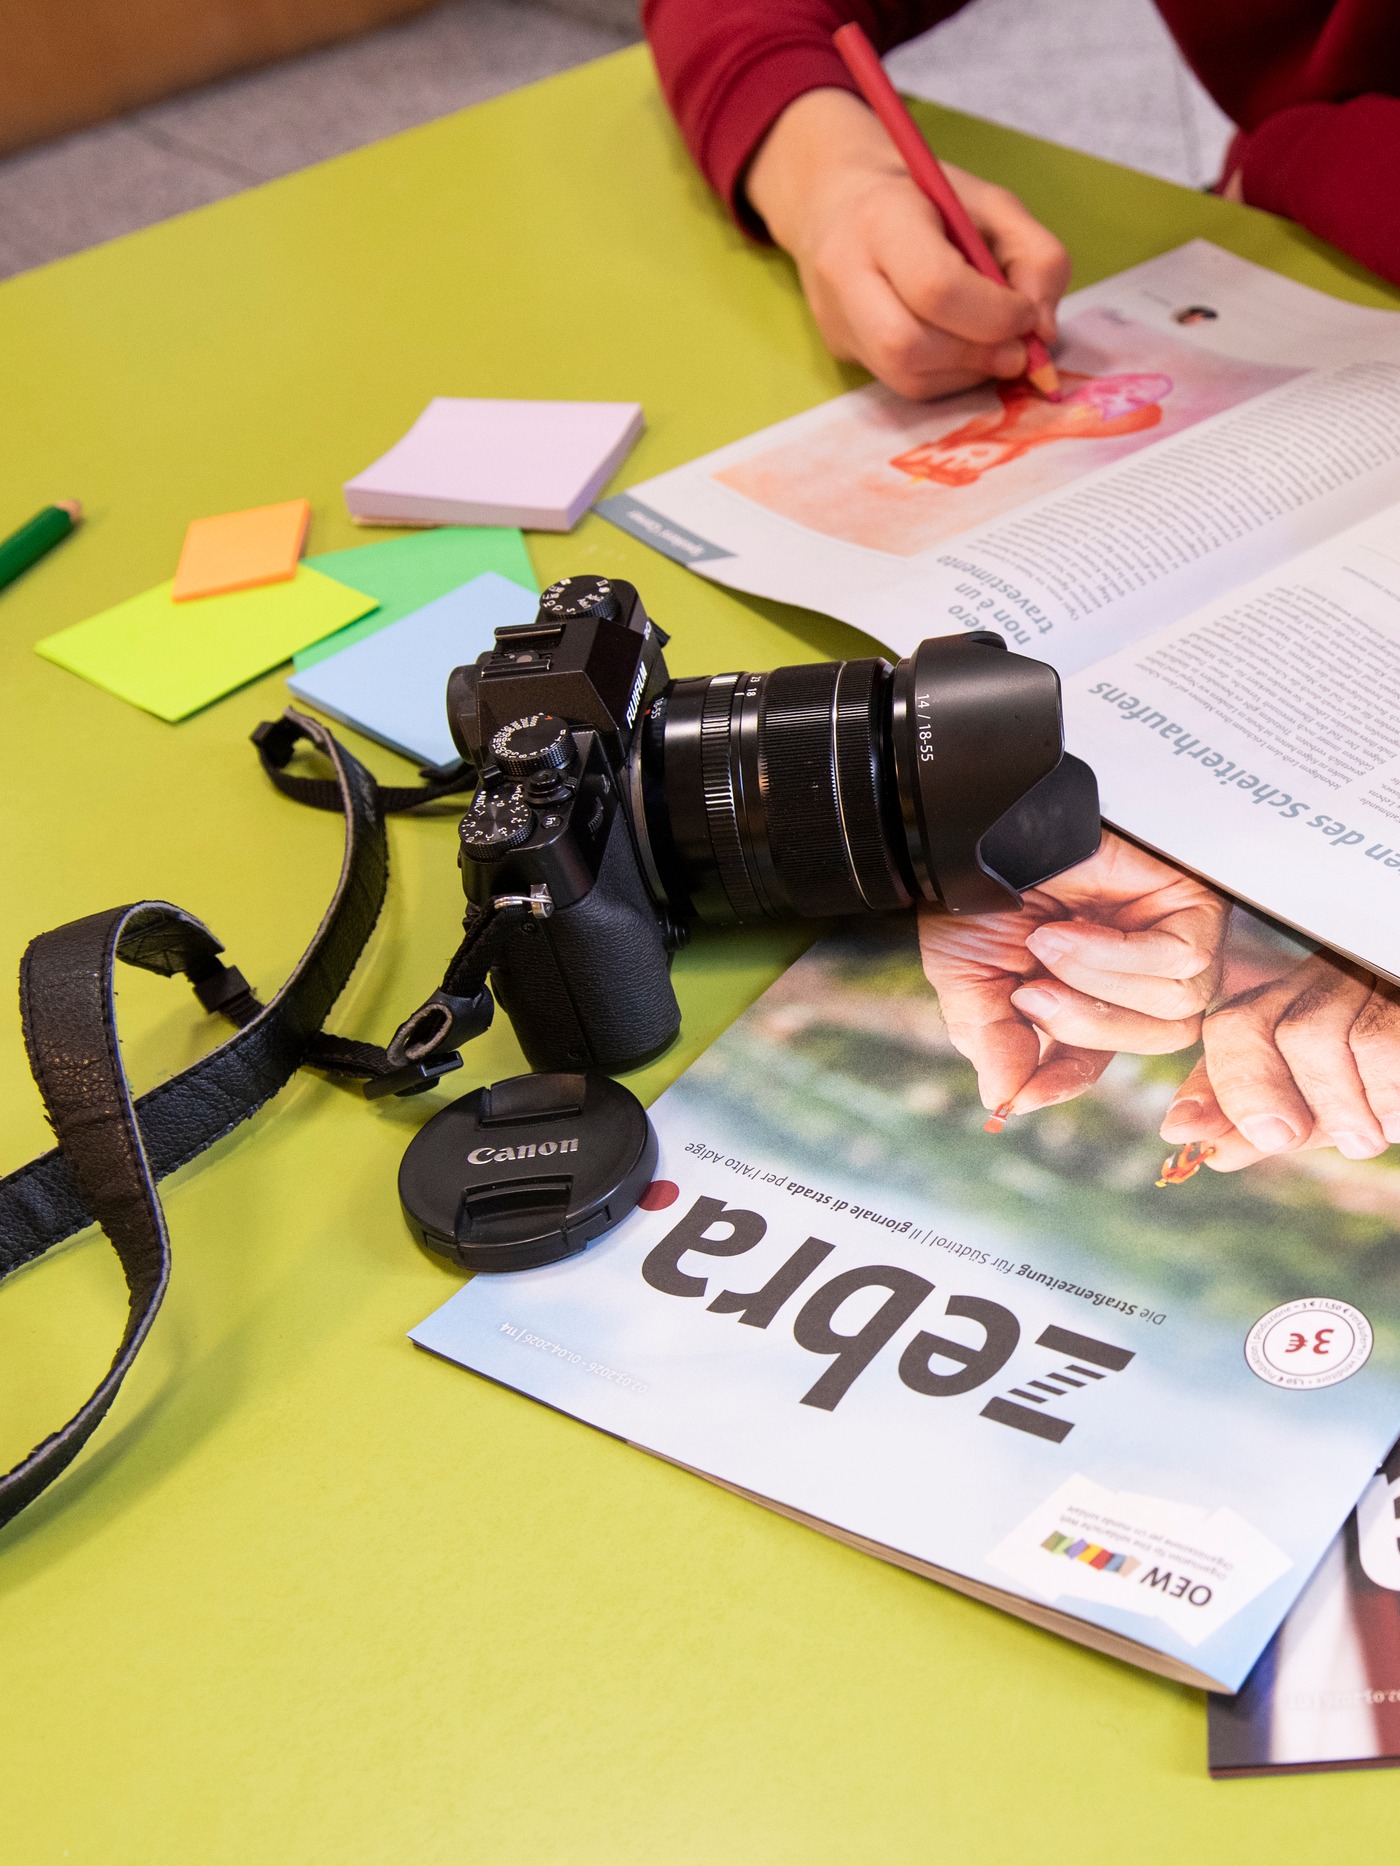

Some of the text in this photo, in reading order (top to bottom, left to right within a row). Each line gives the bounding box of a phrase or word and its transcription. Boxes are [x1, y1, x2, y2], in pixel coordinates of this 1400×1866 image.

[936, 555, 1053, 634] travestimento
[955, 583, 1031, 645] non è un
[917, 693, 934, 762] 14 18-55
[1088, 680, 1310, 820] Scheiterhaufens
[1365, 790, 1398, 807] Lebens
[1305, 813, 1364, 852] des
[467, 1137, 580, 1165] Canon
[684, 1139, 726, 1167] Adige
[761, 1168, 789, 1189] per
[785, 1181, 833, 1209] strada
[830, 1197, 850, 1215] di
[850, 1202, 913, 1238] giornale
[930, 1234, 992, 1268] Südtirol
[990, 1256, 1016, 1277] für
[1015, 1263, 1139, 1319] Straßenzeitung
[1139, 1307, 1167, 1327] Die
[521, 1333, 582, 1364] 01.04.2026
[588, 1362, 648, 1393] 02.03.2026
[1140, 1566, 1212, 1607] OEW
